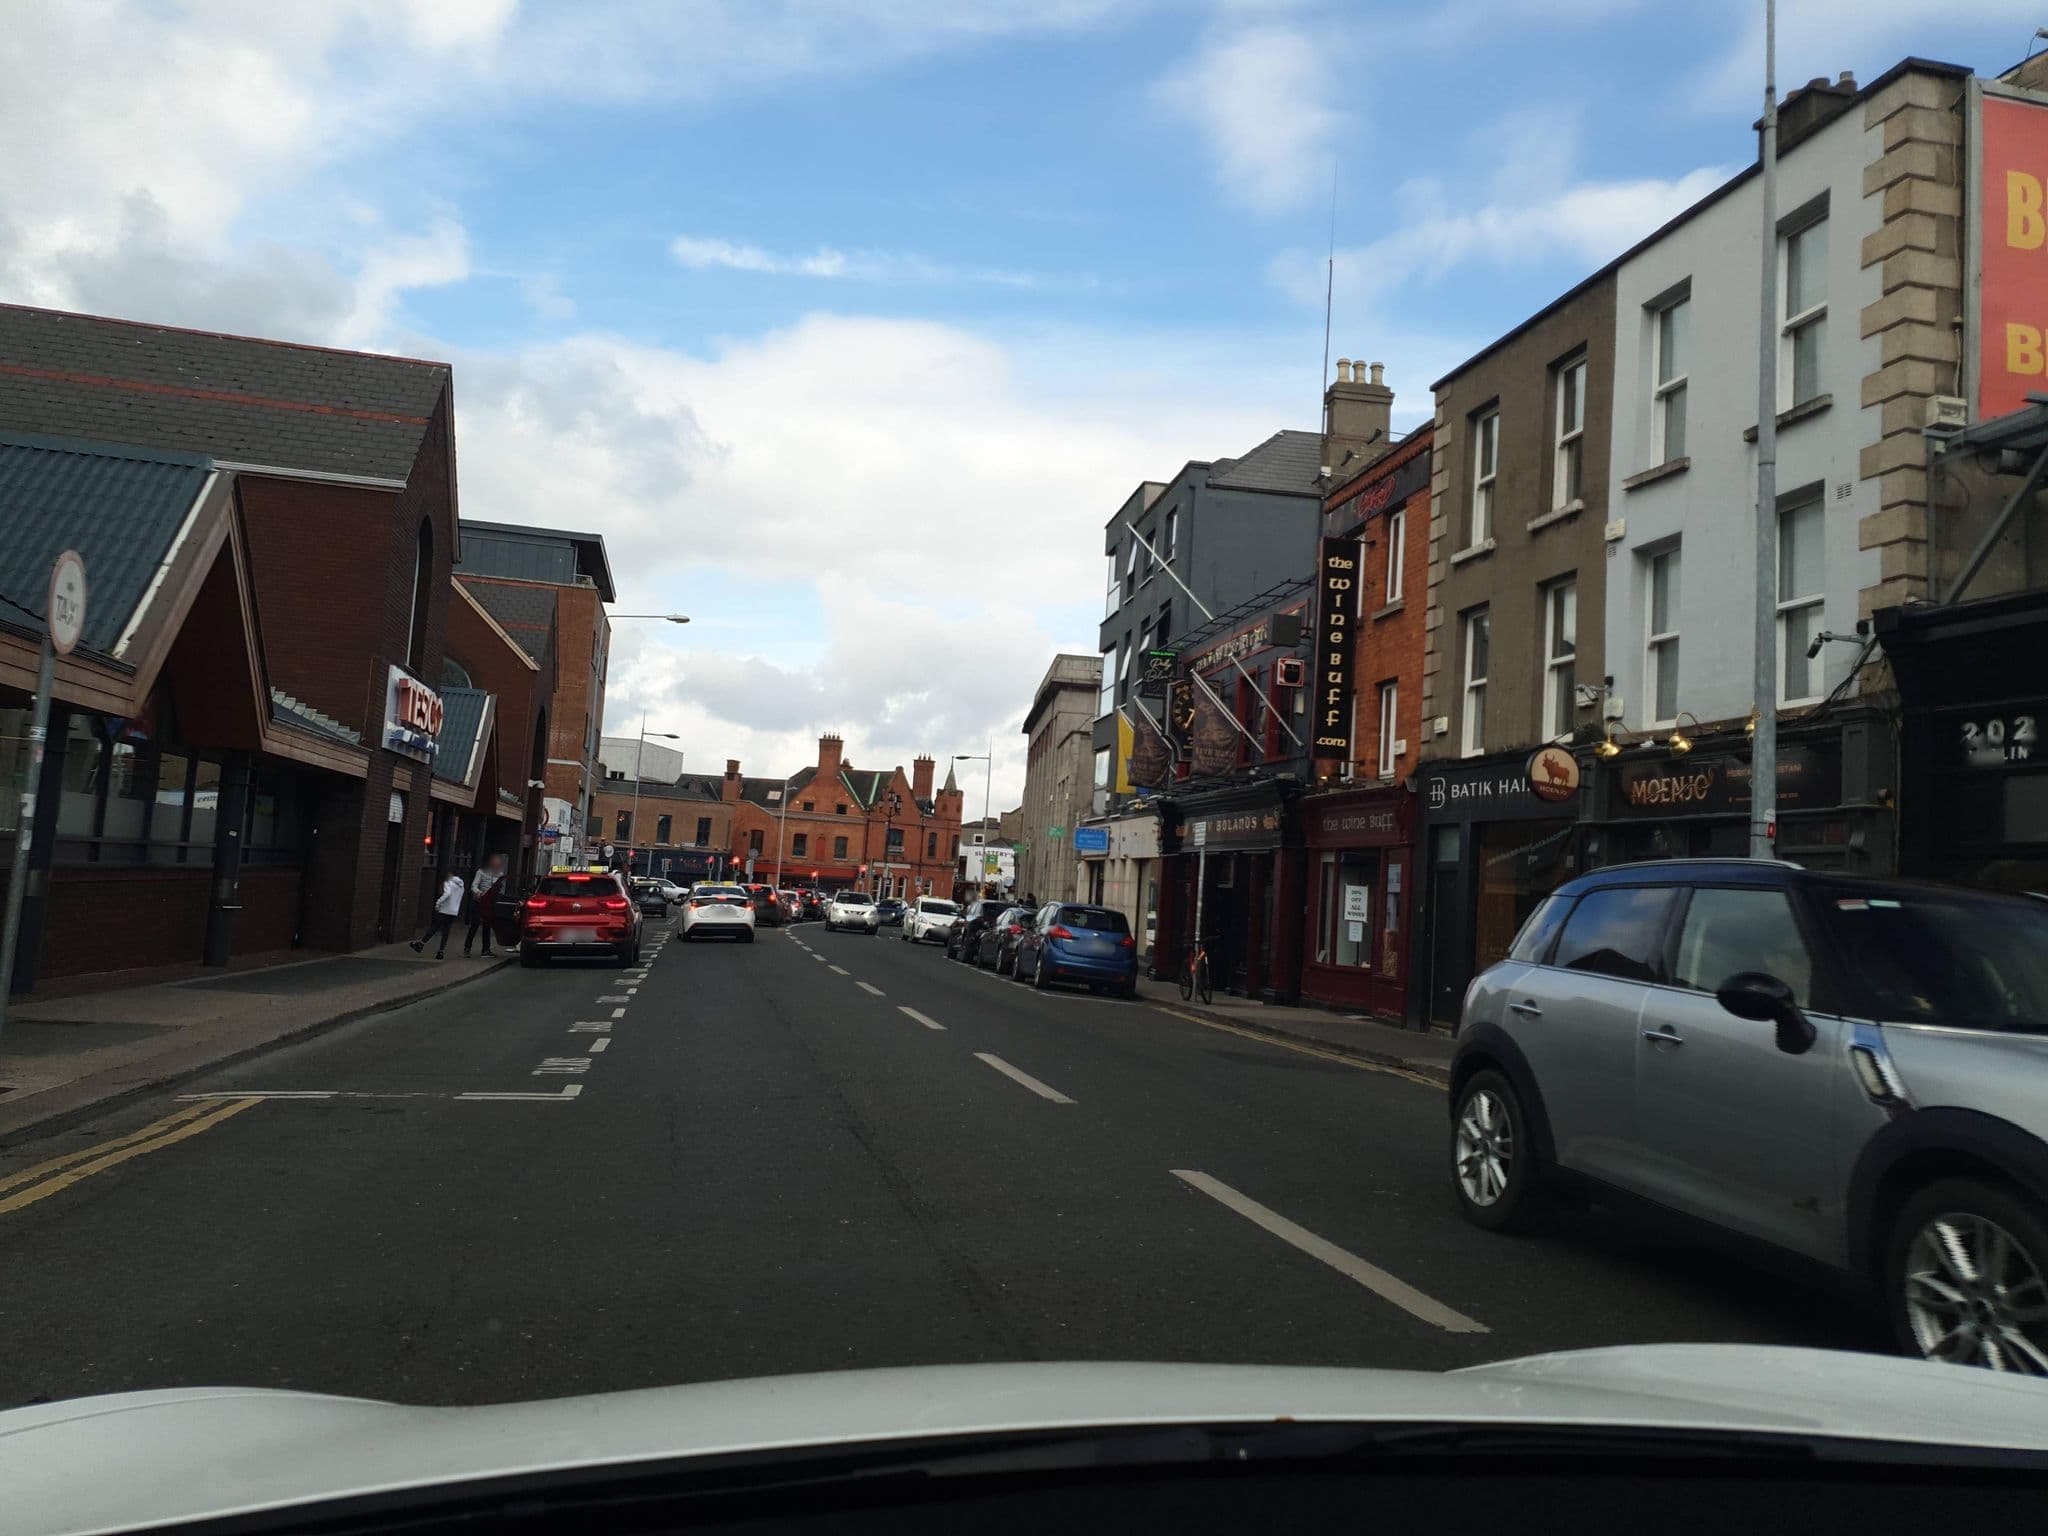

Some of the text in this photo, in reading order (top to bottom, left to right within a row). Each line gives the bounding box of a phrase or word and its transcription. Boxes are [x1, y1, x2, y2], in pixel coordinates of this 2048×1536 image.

[1328, 556, 1353, 569] the
[399, 678, 443, 736] TESCO
[1316, 737, 1346, 747] .com
[1451, 777, 1530, 799] BATIK HAI
[1632, 772, 1710, 804] MOENJO
